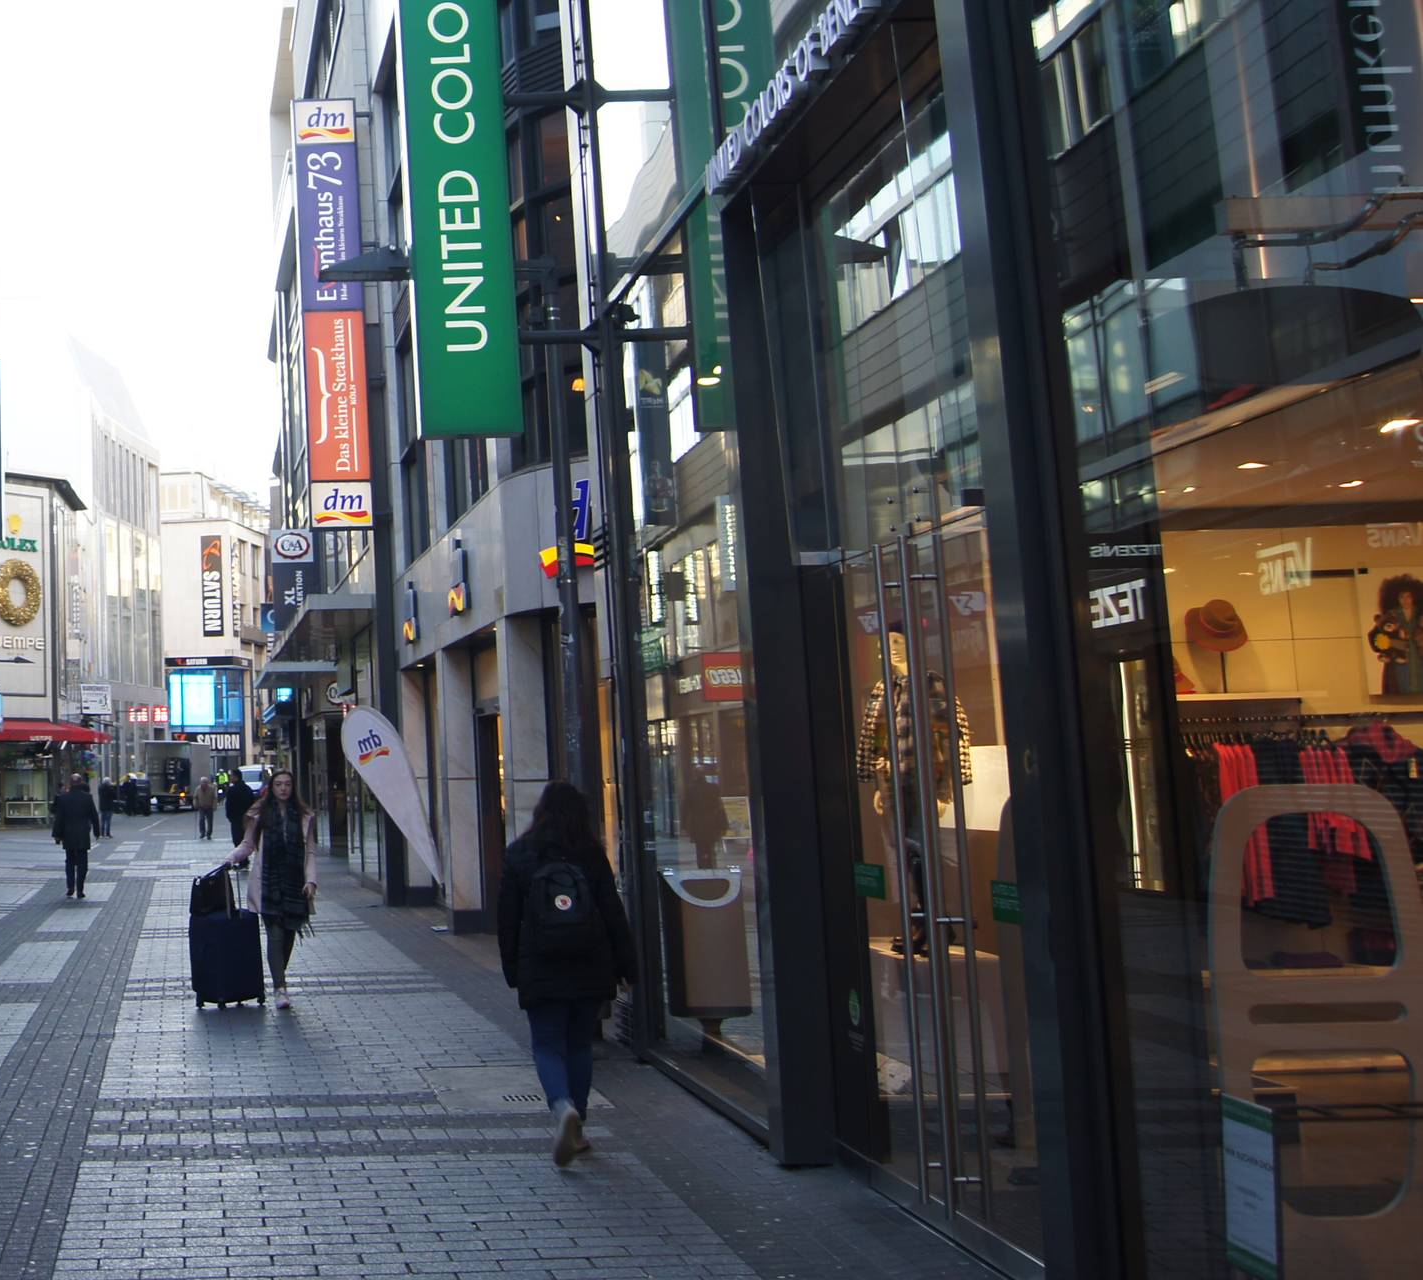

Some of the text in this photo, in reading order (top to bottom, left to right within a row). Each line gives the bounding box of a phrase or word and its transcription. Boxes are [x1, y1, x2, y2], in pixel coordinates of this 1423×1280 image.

[307, 107, 345, 128] dm
[704, 127, 740, 197] UNITED
[743, 58, 793, 147] COLORS
[795, 27, 821, 83] OF
[306, 151, 343, 190] 73
[426, 1, 488, 353] UNITED COLO
[330, 318, 350, 473] Das kleine Steakhaus
[349, 384, 357, 405] KÖLN
[324, 488, 363, 511] dm
[280, 539, 304, 552] C&A
[202, 570, 223, 632] SATURN
[284, 587, 296, 605] XL
[197, 734, 240, 750] SATURN
